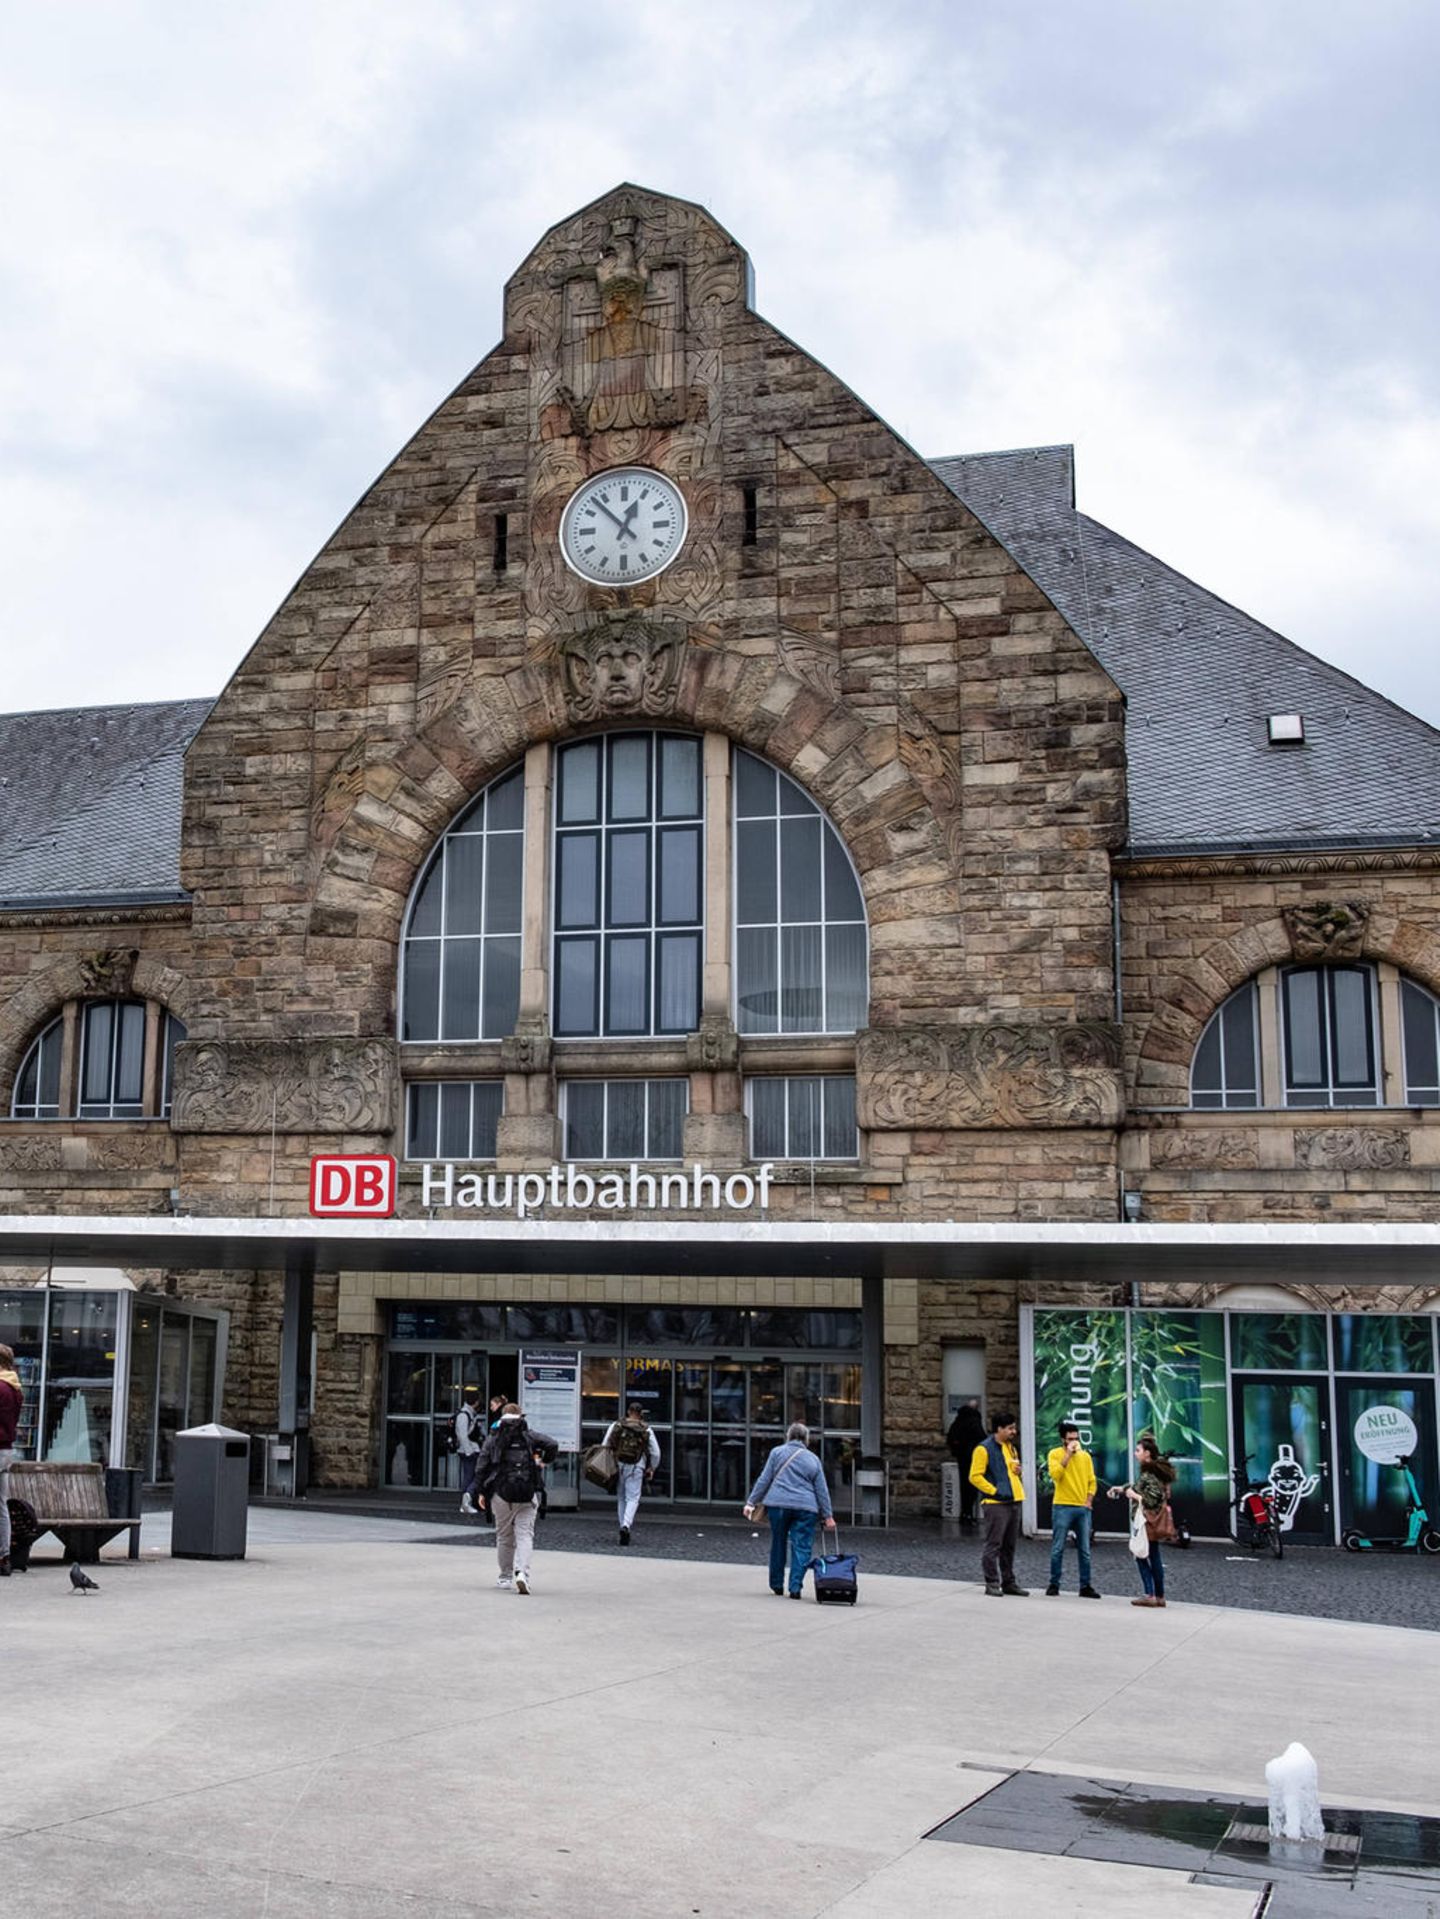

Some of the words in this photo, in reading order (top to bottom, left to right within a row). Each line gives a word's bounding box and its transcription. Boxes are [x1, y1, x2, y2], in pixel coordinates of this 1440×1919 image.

[321, 1164, 385, 1207] DB
[421, 1163, 774, 1218] Hauptbahnhof
[1367, 1413, 1397, 1428] NEU
